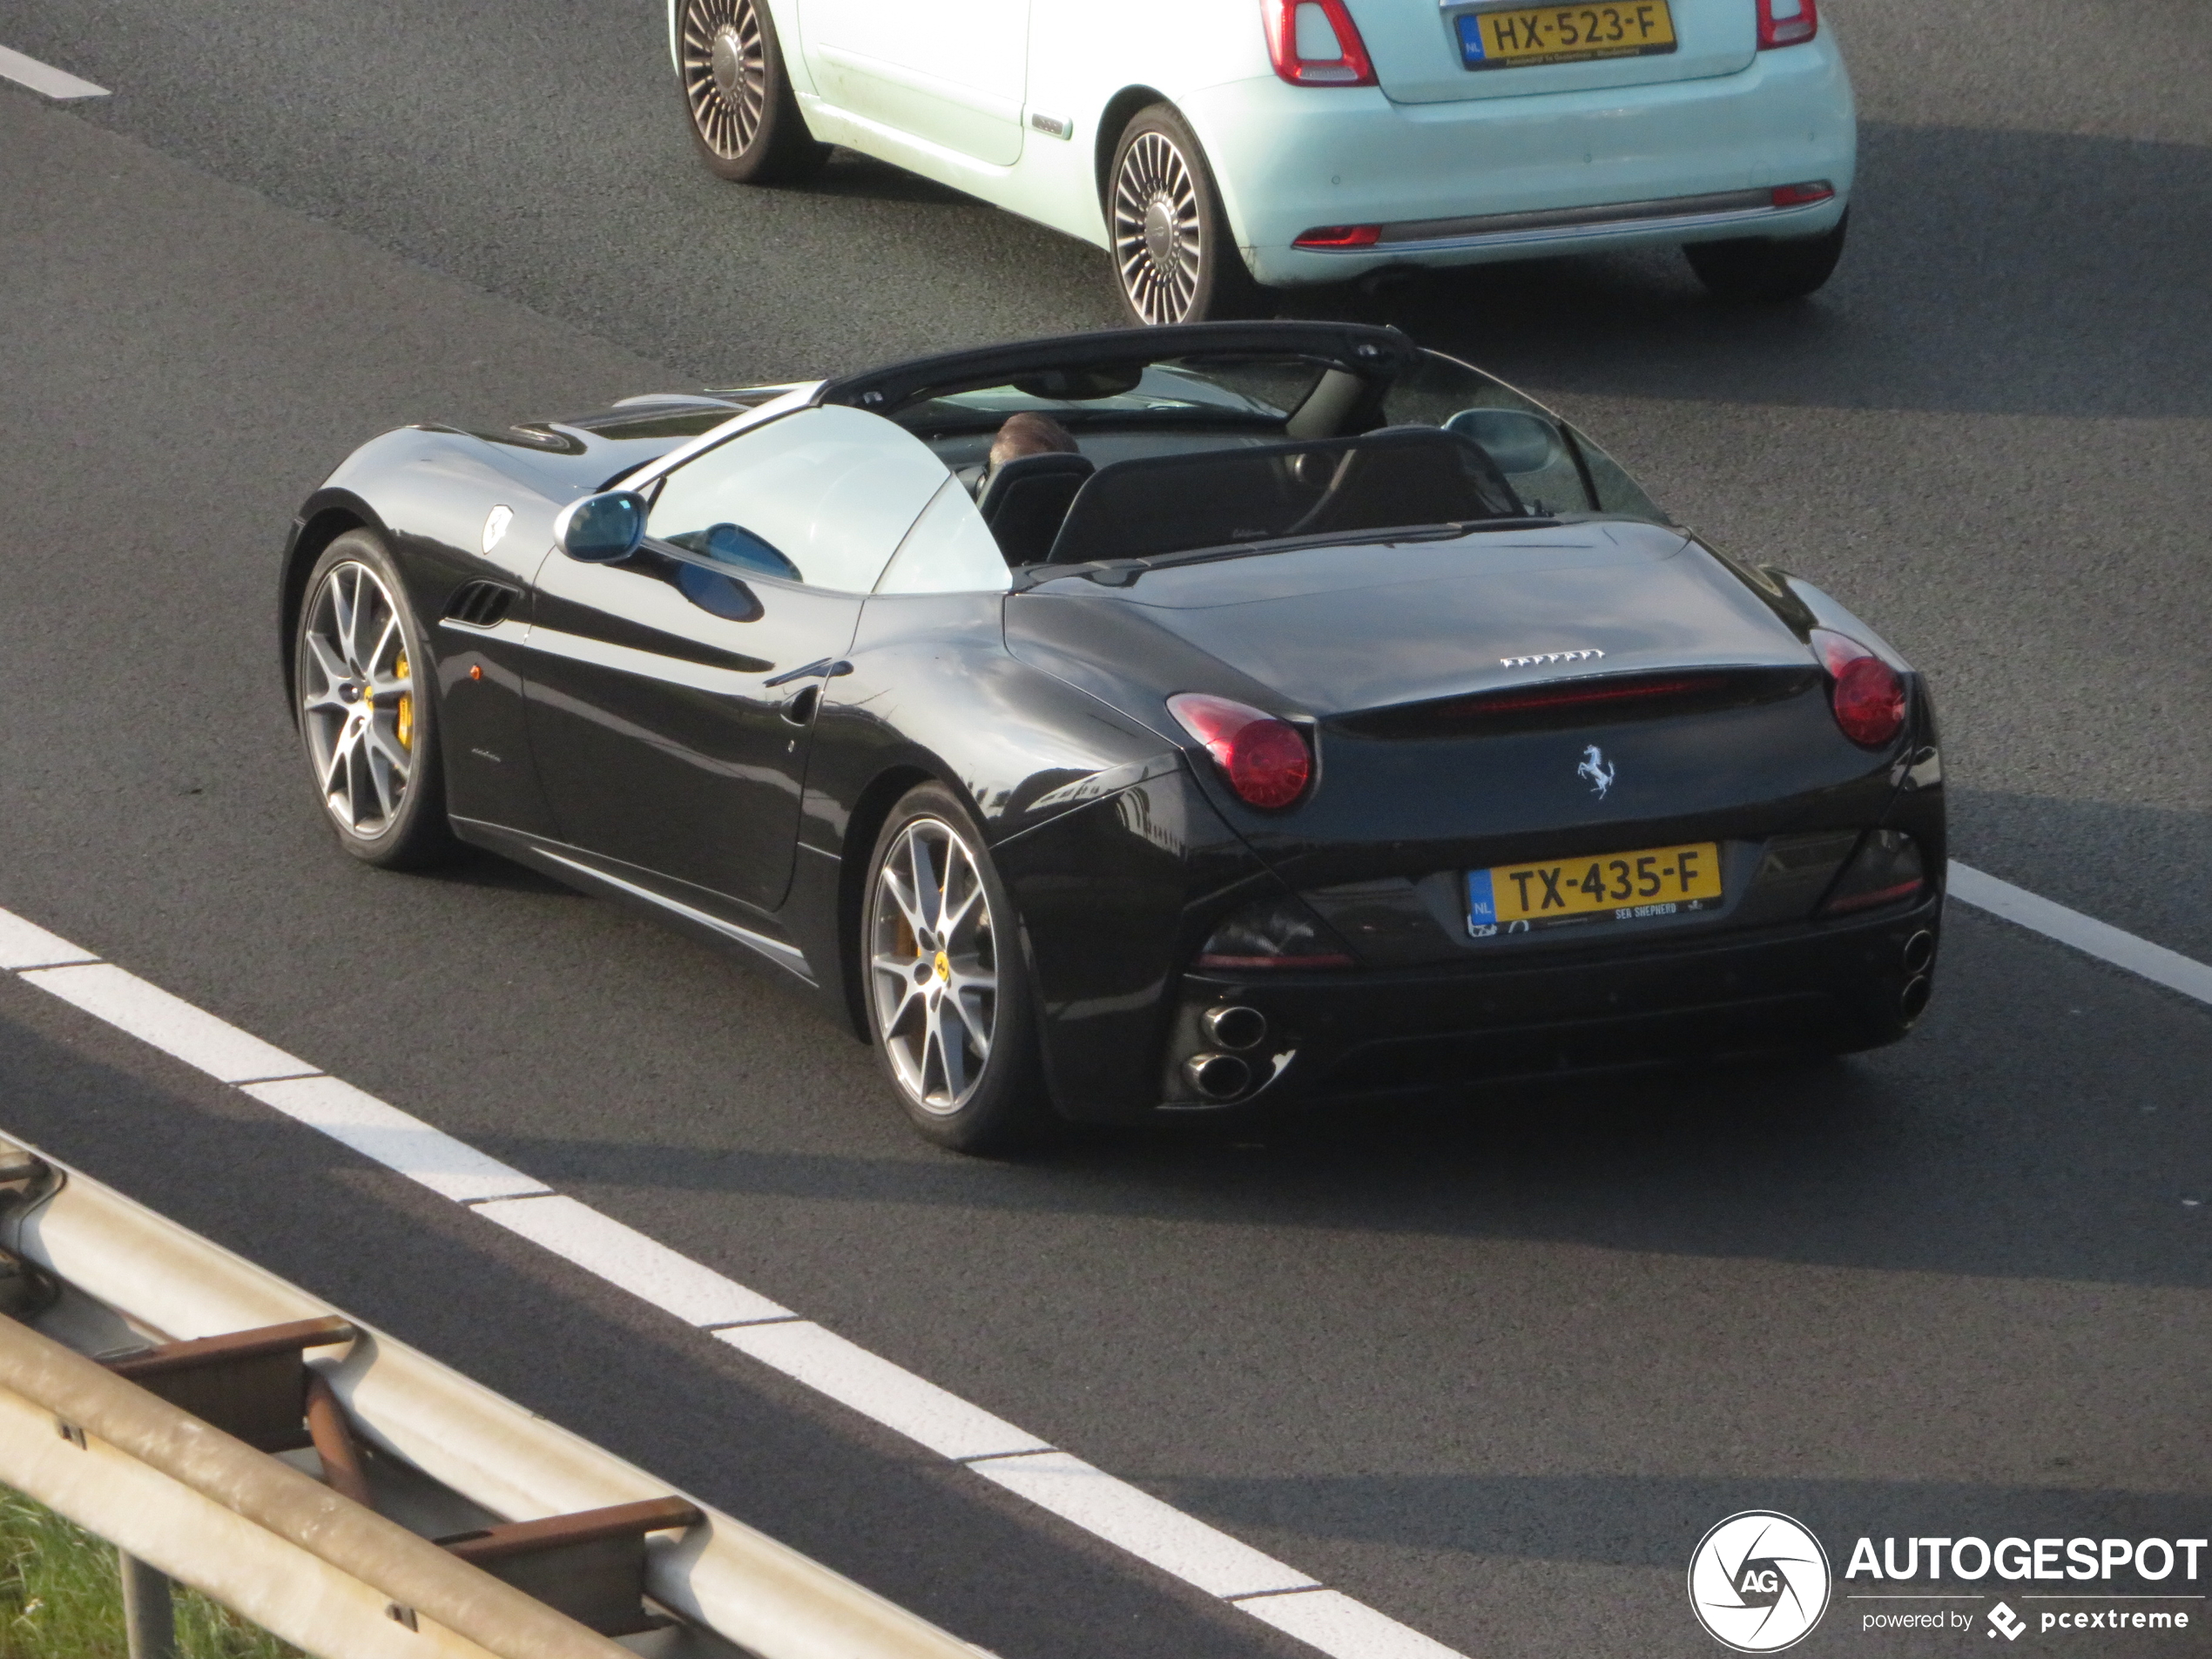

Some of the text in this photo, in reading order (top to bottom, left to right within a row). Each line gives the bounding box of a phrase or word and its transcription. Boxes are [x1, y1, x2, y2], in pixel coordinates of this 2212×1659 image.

[1493, 6, 1655, 51] HX-523-F
[1466, 43, 1480, 52] NL
[1509, 851, 1699, 912] TX-435-F
[1474, 902, 1492, 914] NL
[1615, 902, 1676, 920] SEA SHEPHERD
